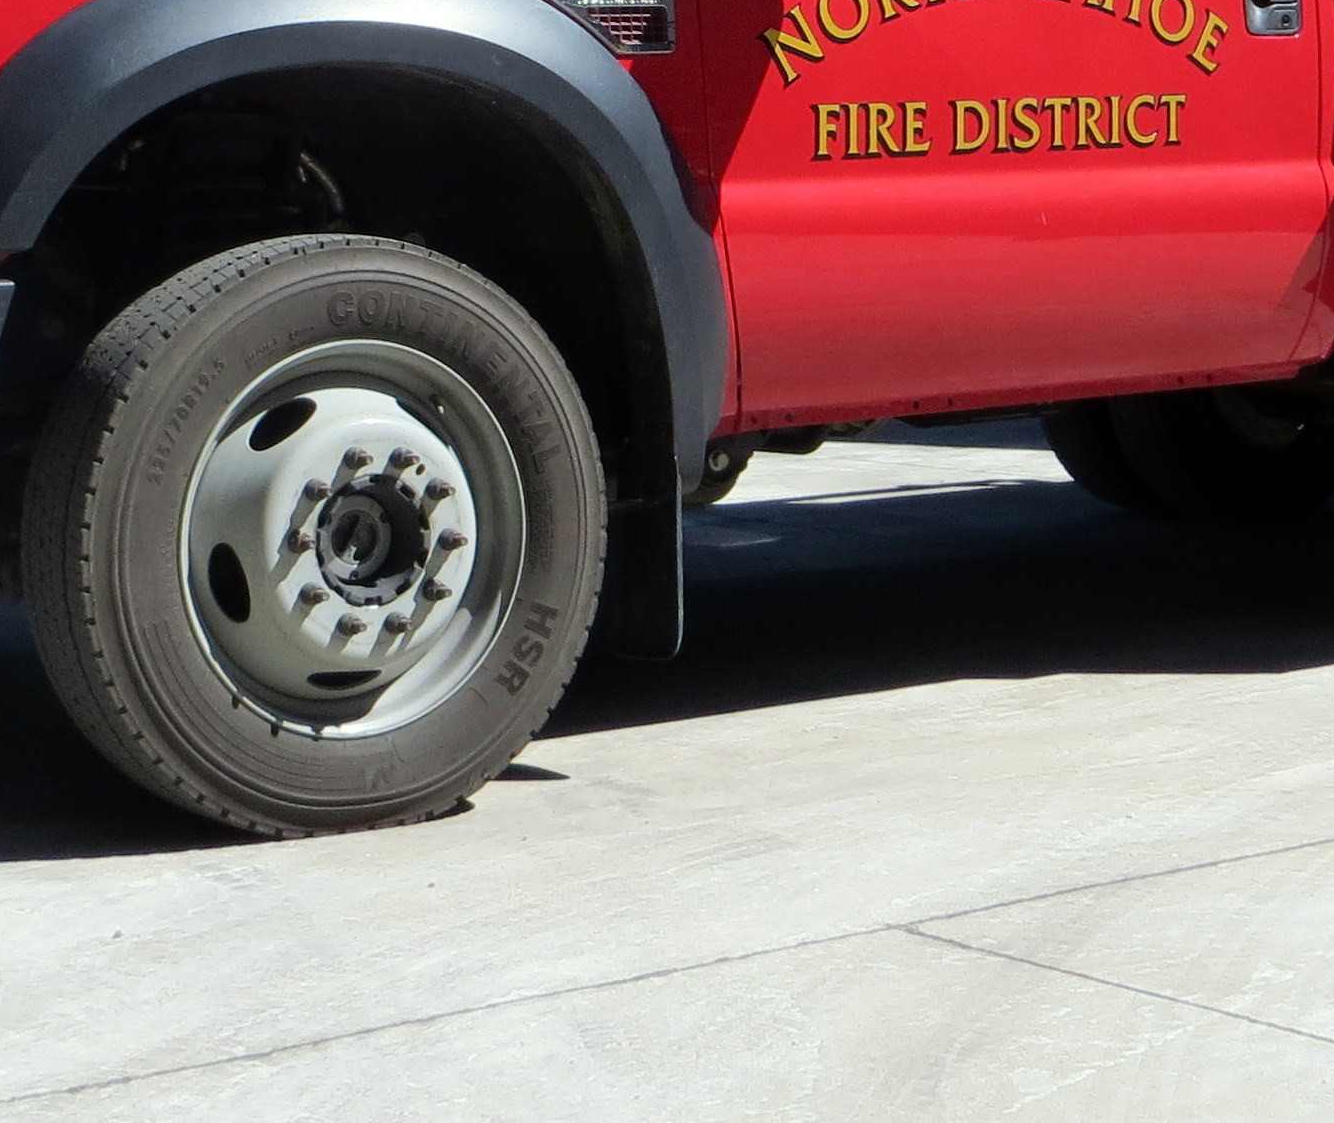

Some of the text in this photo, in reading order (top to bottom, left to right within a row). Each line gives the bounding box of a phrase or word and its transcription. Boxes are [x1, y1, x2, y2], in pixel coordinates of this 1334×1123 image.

[812, 94, 1186, 160] FIRE DISTRICT
[326, 290, 561, 476] CONTINENTAL
[495, 599, 560, 697] HSR
